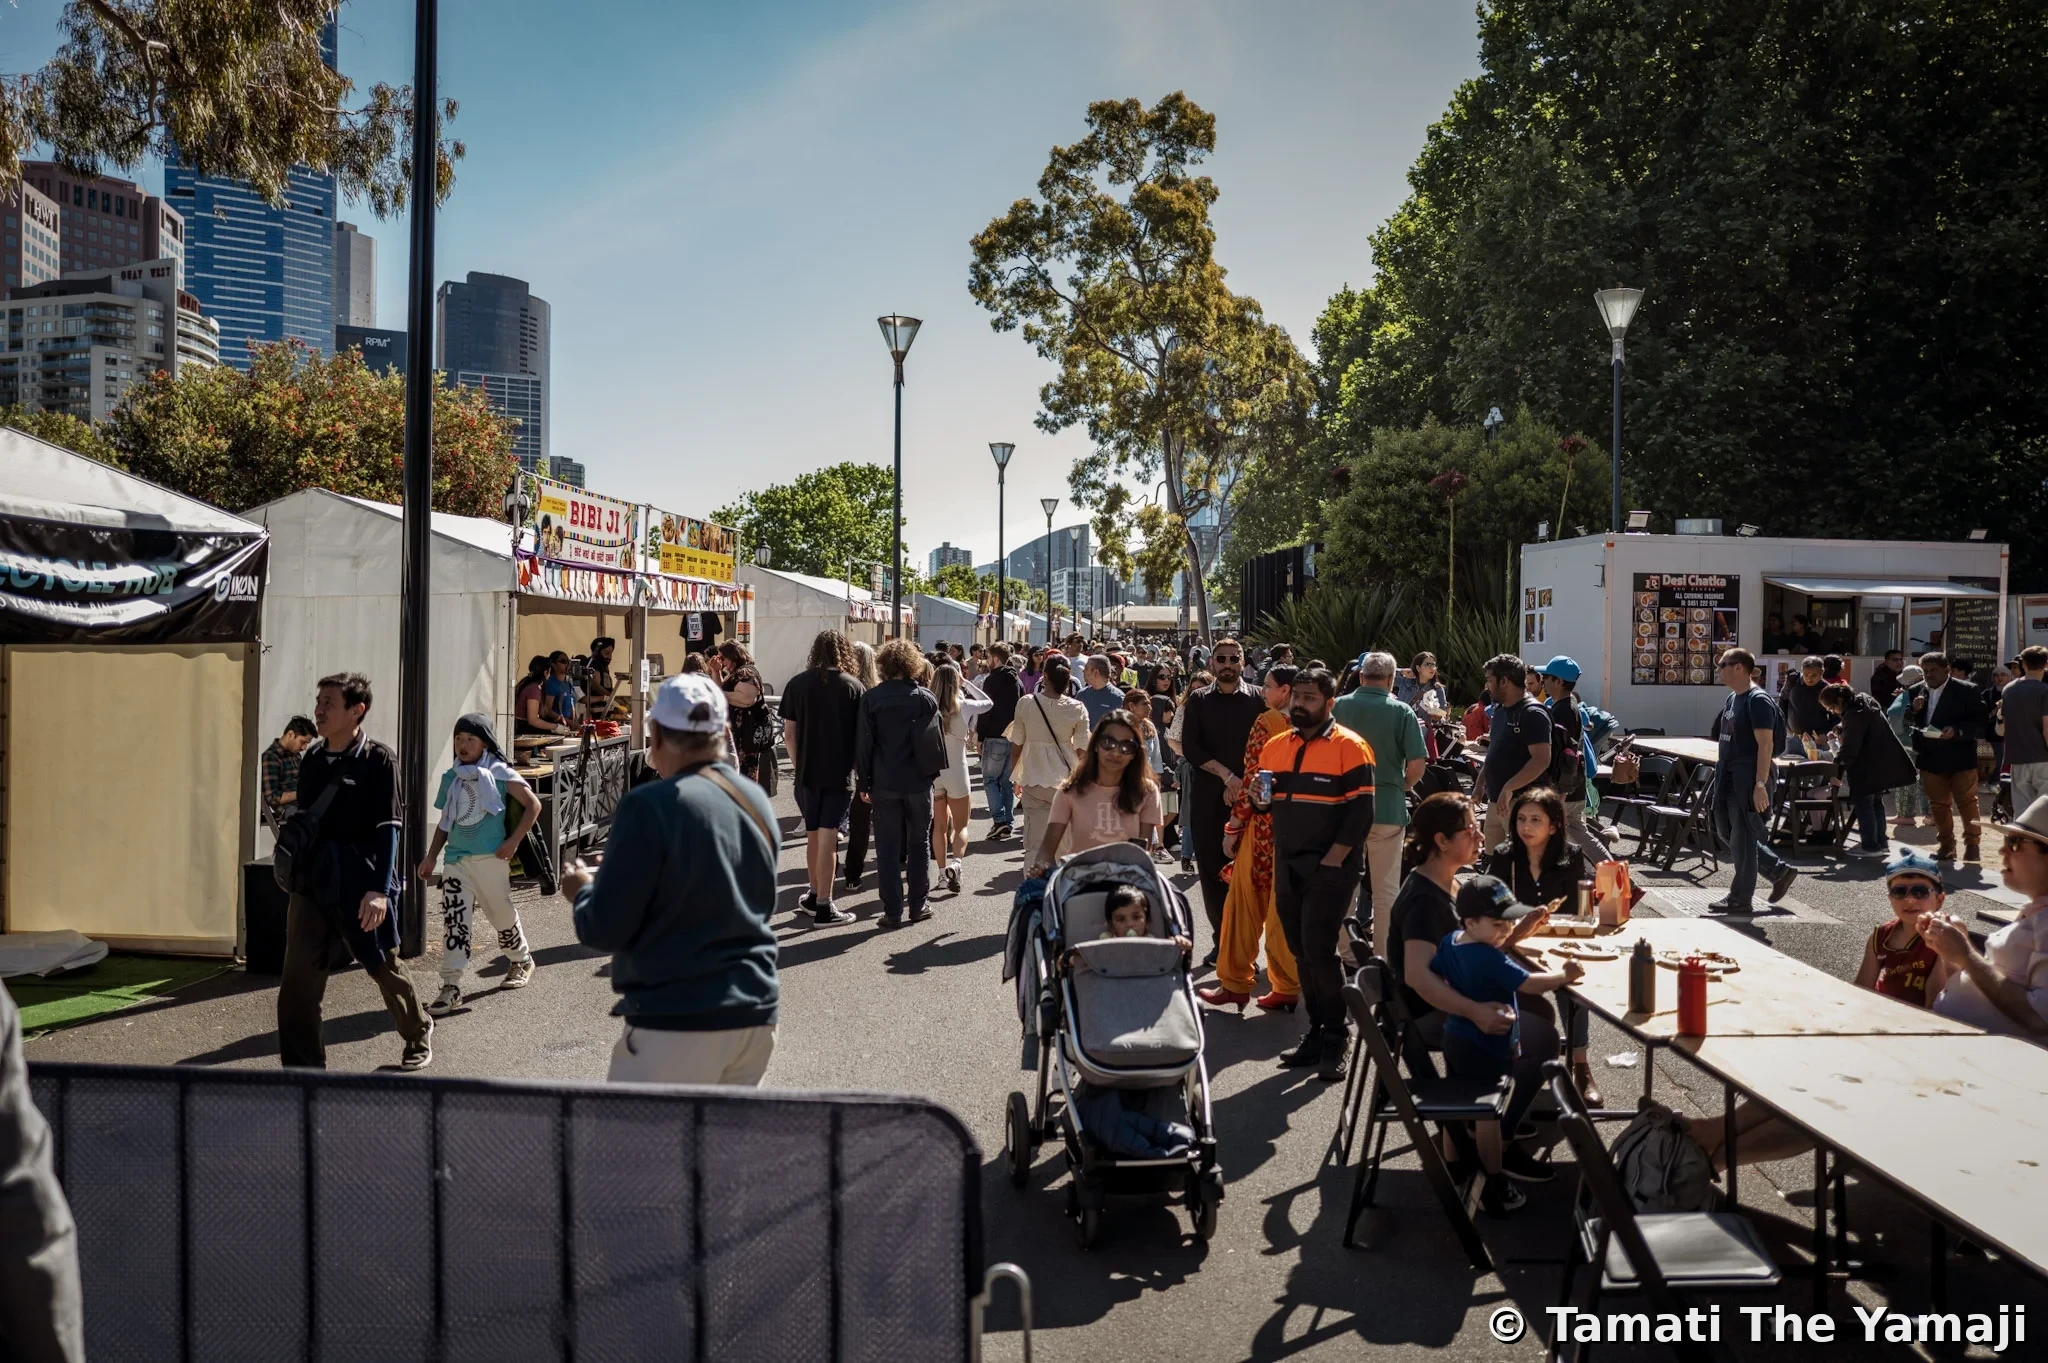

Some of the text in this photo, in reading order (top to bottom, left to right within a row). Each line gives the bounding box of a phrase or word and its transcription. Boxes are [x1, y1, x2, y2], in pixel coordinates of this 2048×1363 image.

[120, 266, 171, 281] QUAY WEST
[570, 500, 602, 531] BIBI
[606, 509, 620, 534] JI
[116, 562, 178, 596] HUB
[1662, 574, 1686, 586] Desi
[1687, 575, 1727, 587] Chatka
[1683, 592, 1703, 600] CATERING
[1904, 971, 1925, 992] 14
